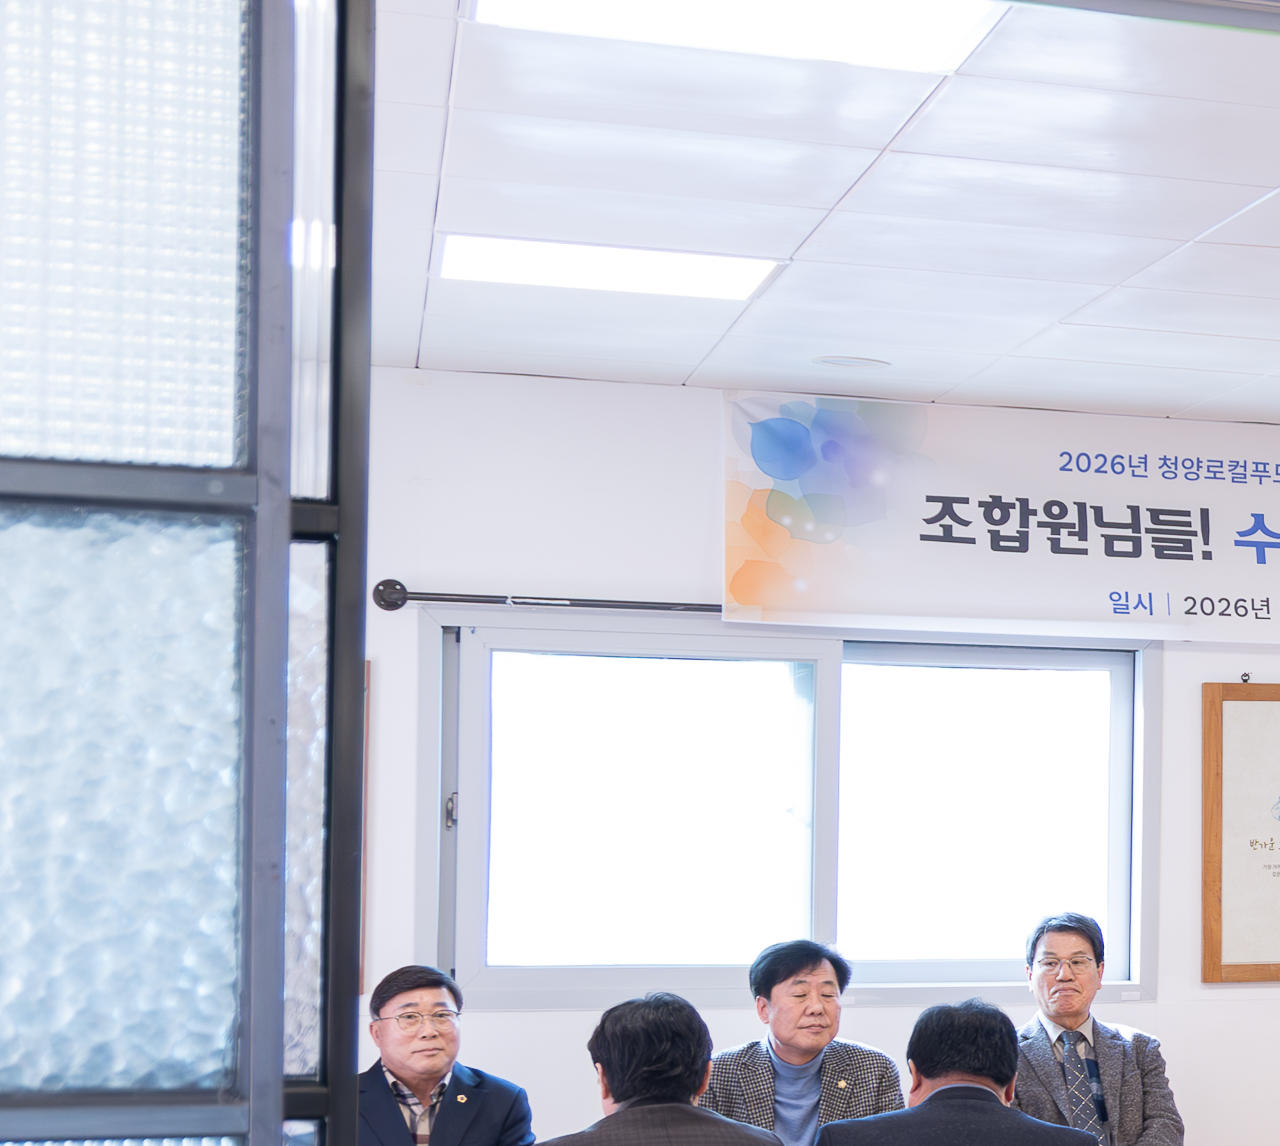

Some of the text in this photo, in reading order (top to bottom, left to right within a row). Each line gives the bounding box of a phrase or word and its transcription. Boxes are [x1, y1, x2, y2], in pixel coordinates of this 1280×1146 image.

[1058, 450, 1149, 479] 2026년
[919, 494, 1213, 562] 조합원님들!
[1108, 591, 1154, 616] 일시
[1183, 596, 1271, 620] 2026년
[1249, 837, 1275, 850] 반가운
